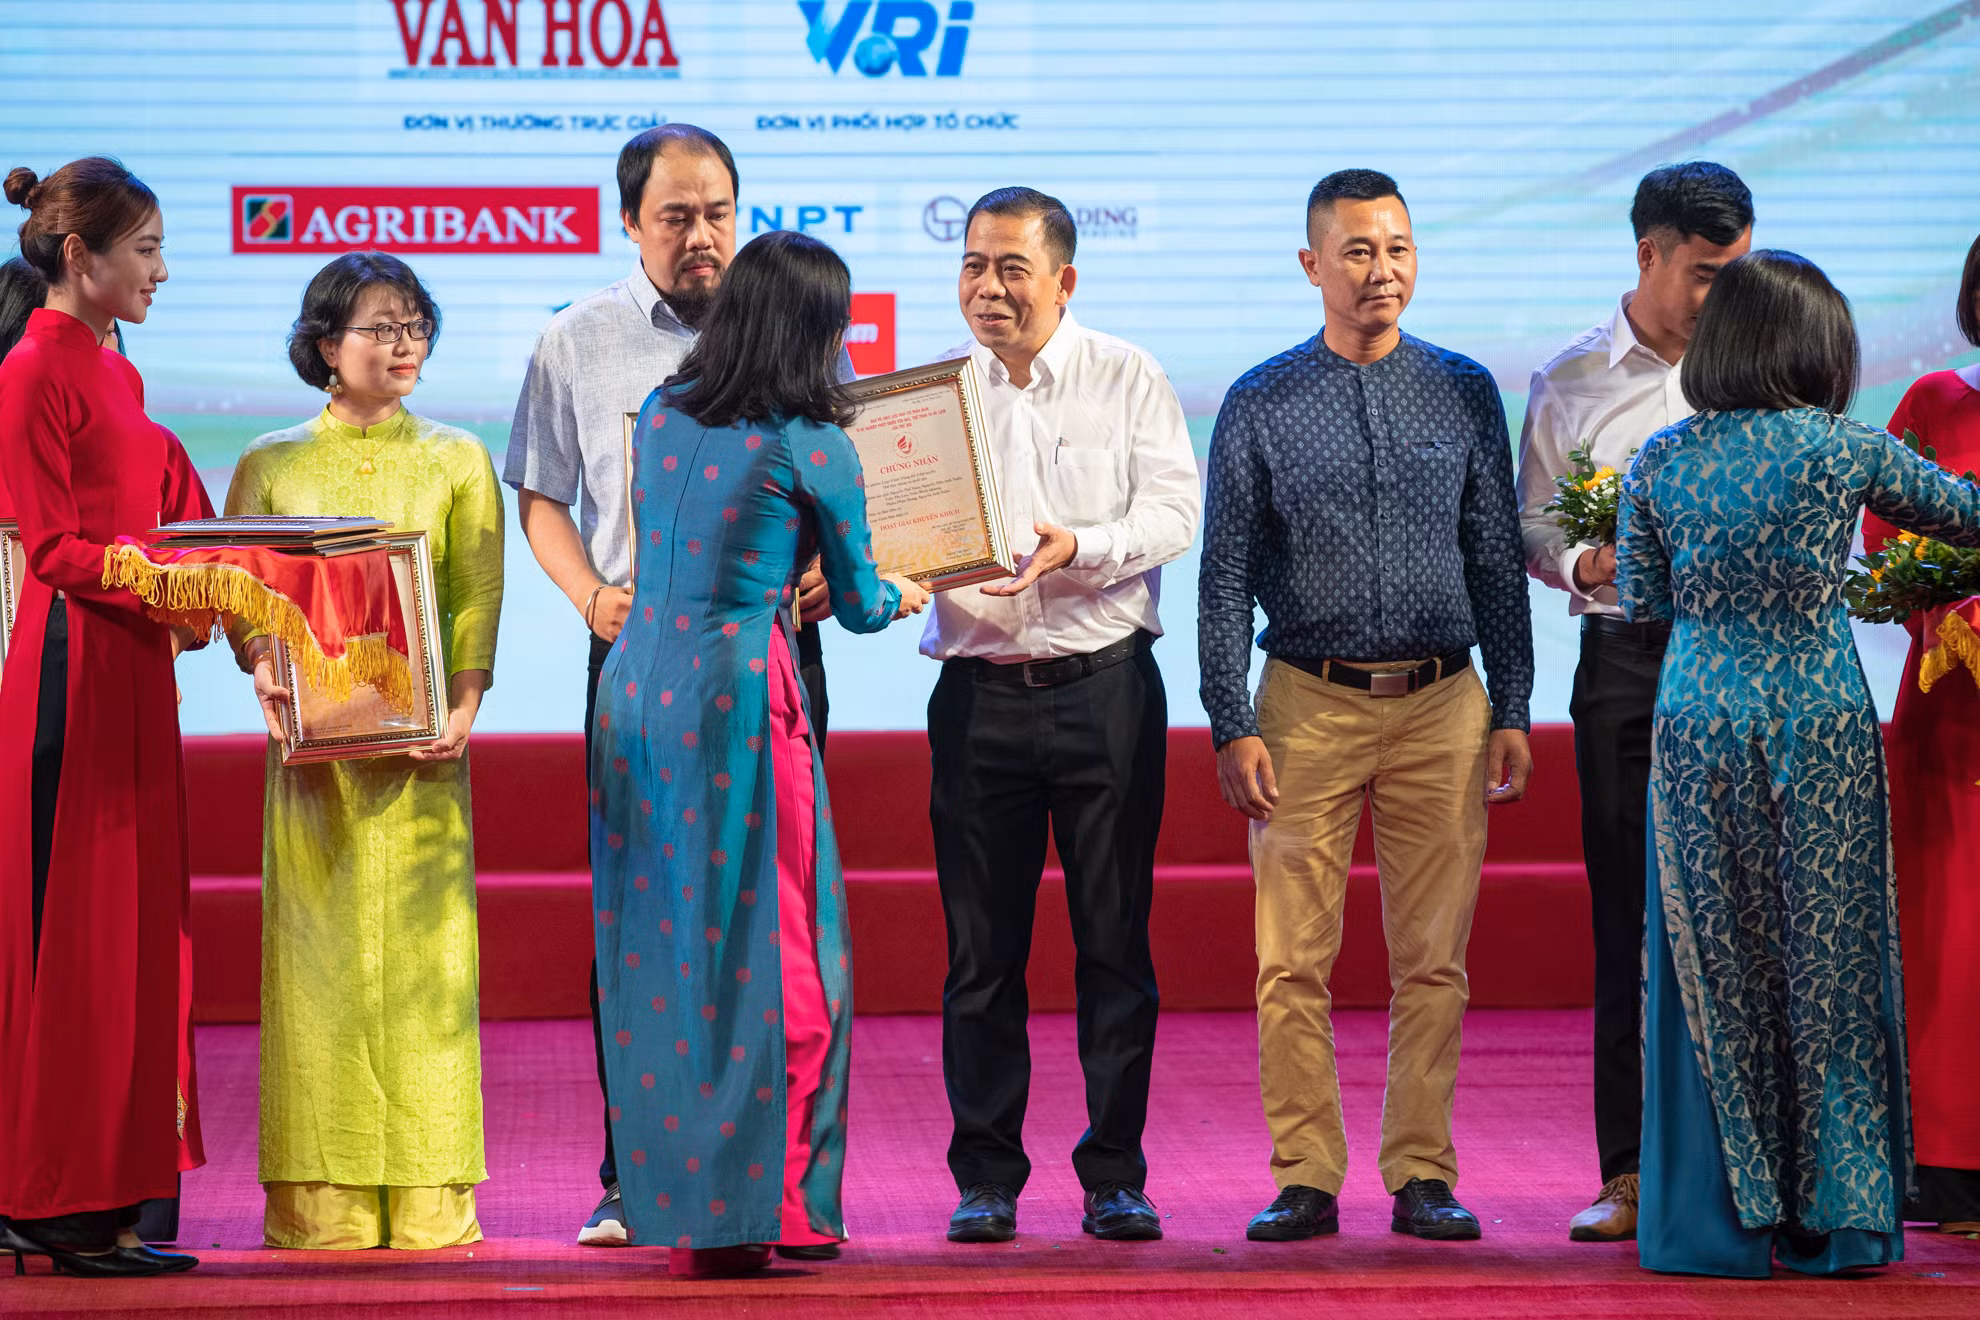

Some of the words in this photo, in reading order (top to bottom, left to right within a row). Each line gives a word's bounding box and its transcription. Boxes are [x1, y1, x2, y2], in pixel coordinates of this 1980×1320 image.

[301, 206, 580, 244] AGRIBANK
[737, 205, 864, 233] NPT
[880, 461, 911, 474] CHỨNG
[913, 455, 938, 466] NHẬN
